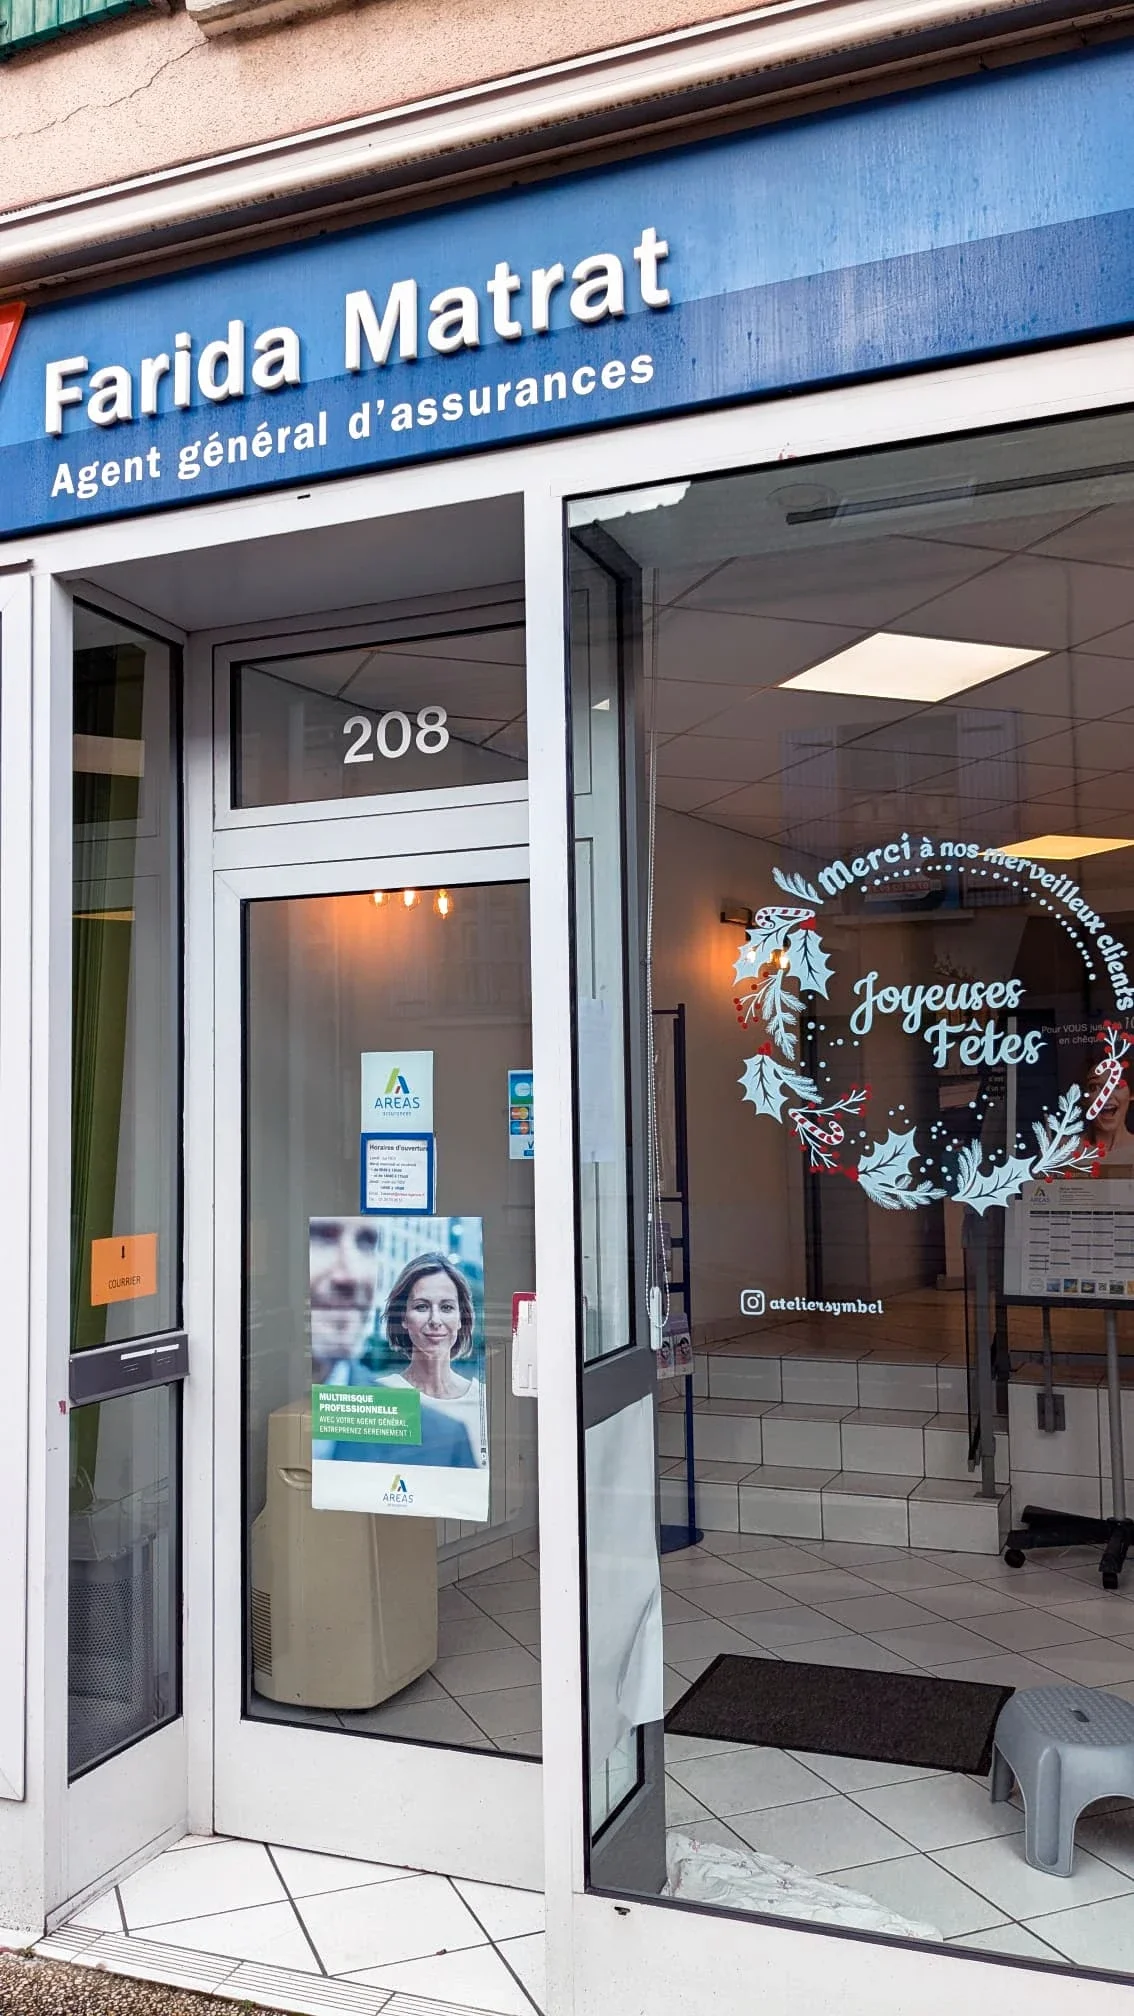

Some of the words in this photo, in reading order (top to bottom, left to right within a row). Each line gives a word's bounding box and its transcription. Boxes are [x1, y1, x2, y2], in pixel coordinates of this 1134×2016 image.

[45, 319, 301, 435] Farida
[344, 226, 671, 372] Matrat
[50, 446, 161, 499] Agent
[177, 410, 327, 480] général
[348, 354, 655, 440] d’assurances
[343, 705, 450, 764] 208
[818, 832, 911, 895] Merci
[919, 836, 935, 858] à
[939, 842, 980, 859] nos
[982, 847, 1106, 935] merveilleux
[1096, 934, 1134, 1011] clients
[850, 971, 1028, 1035] Joyeuses
[1041, 1025, 1062, 1034] Pour
[1062, 1023, 1088, 1033] VOUS
[924, 1018, 1048, 1068] Fêtes
[374, 1097, 420, 1109] AREAS
[108, 1275, 141, 1289] COURRIER
[769, 1296, 884, 1316] ateliersymbel
[319, 1392, 374, 1403] MULTIRISQUE
[319, 1403, 399, 1415] PROFESSIONNELLE
[319, 1415, 335, 1423] AVEC
[319, 1426, 362, 1435] ENTREPRENEZ
[363, 1428, 408, 1437] SEREINEMENT
[382, 1493, 414, 1504] AREAS
